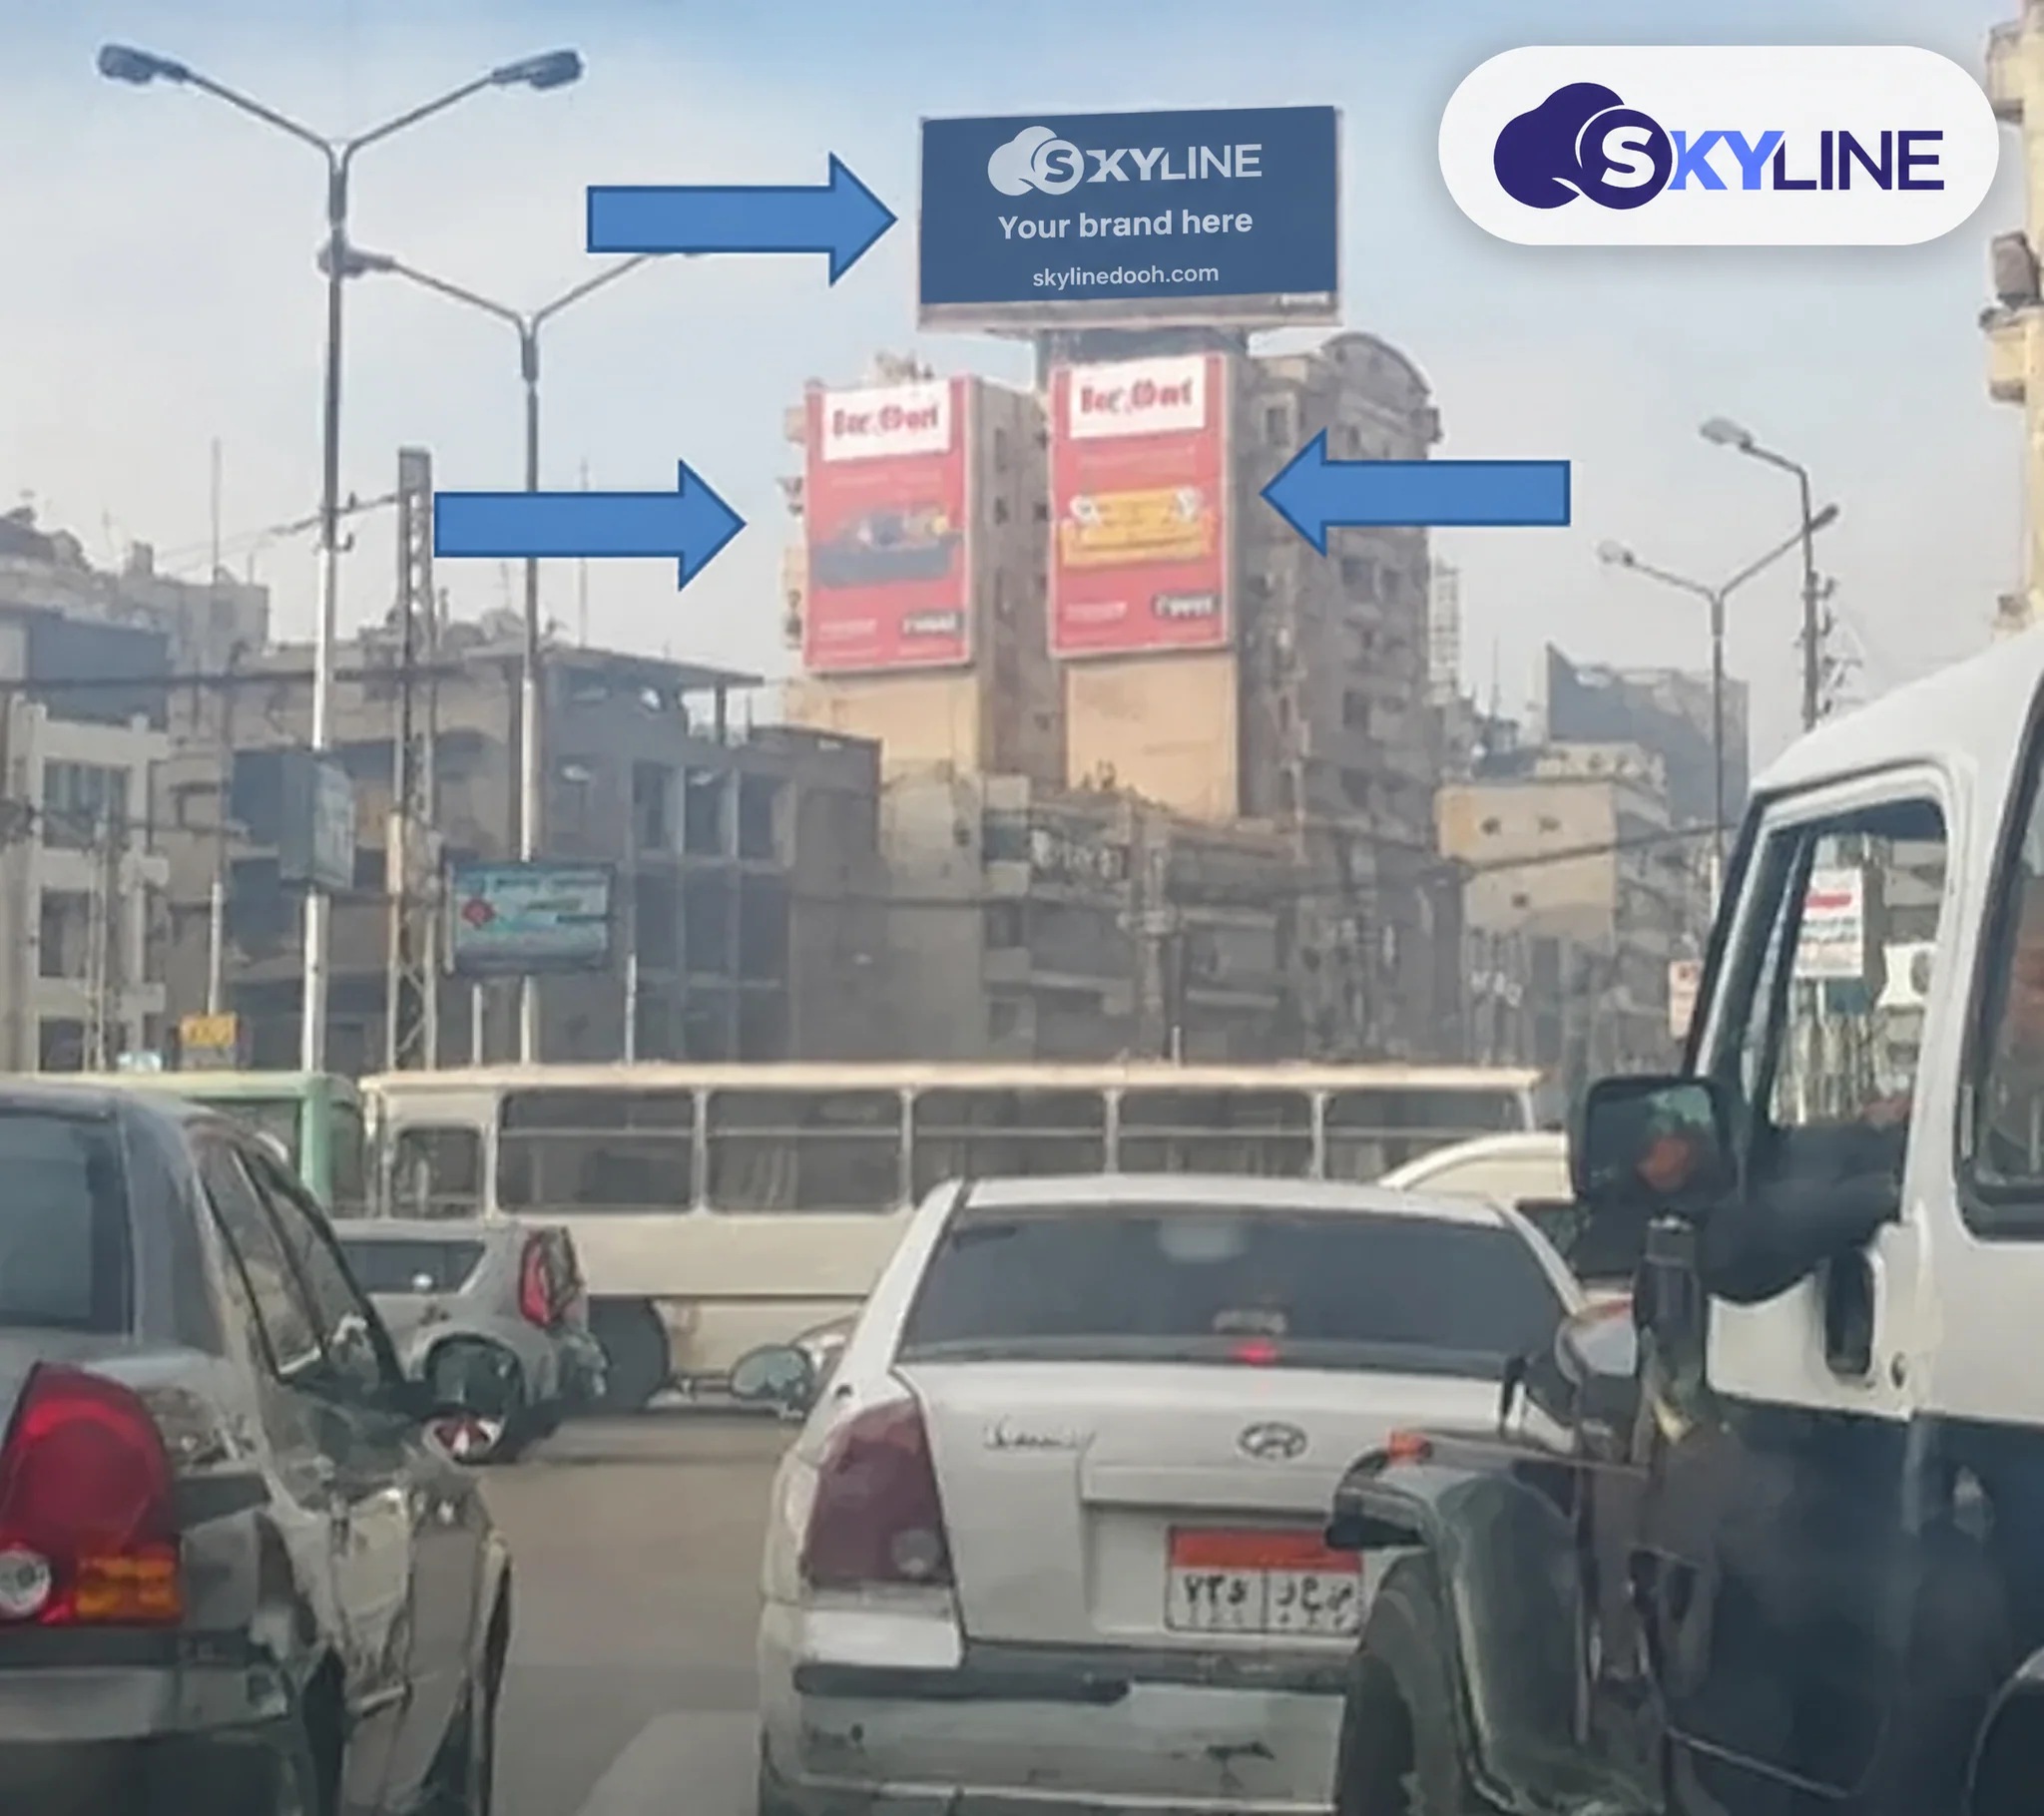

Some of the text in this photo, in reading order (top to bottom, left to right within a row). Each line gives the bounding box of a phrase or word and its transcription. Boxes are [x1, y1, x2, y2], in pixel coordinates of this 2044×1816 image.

[1044, 143, 1263, 184] SKYLINE
[998, 209, 1254, 239] Your brand here
[1033, 264, 1220, 291] skylinedooh.com
